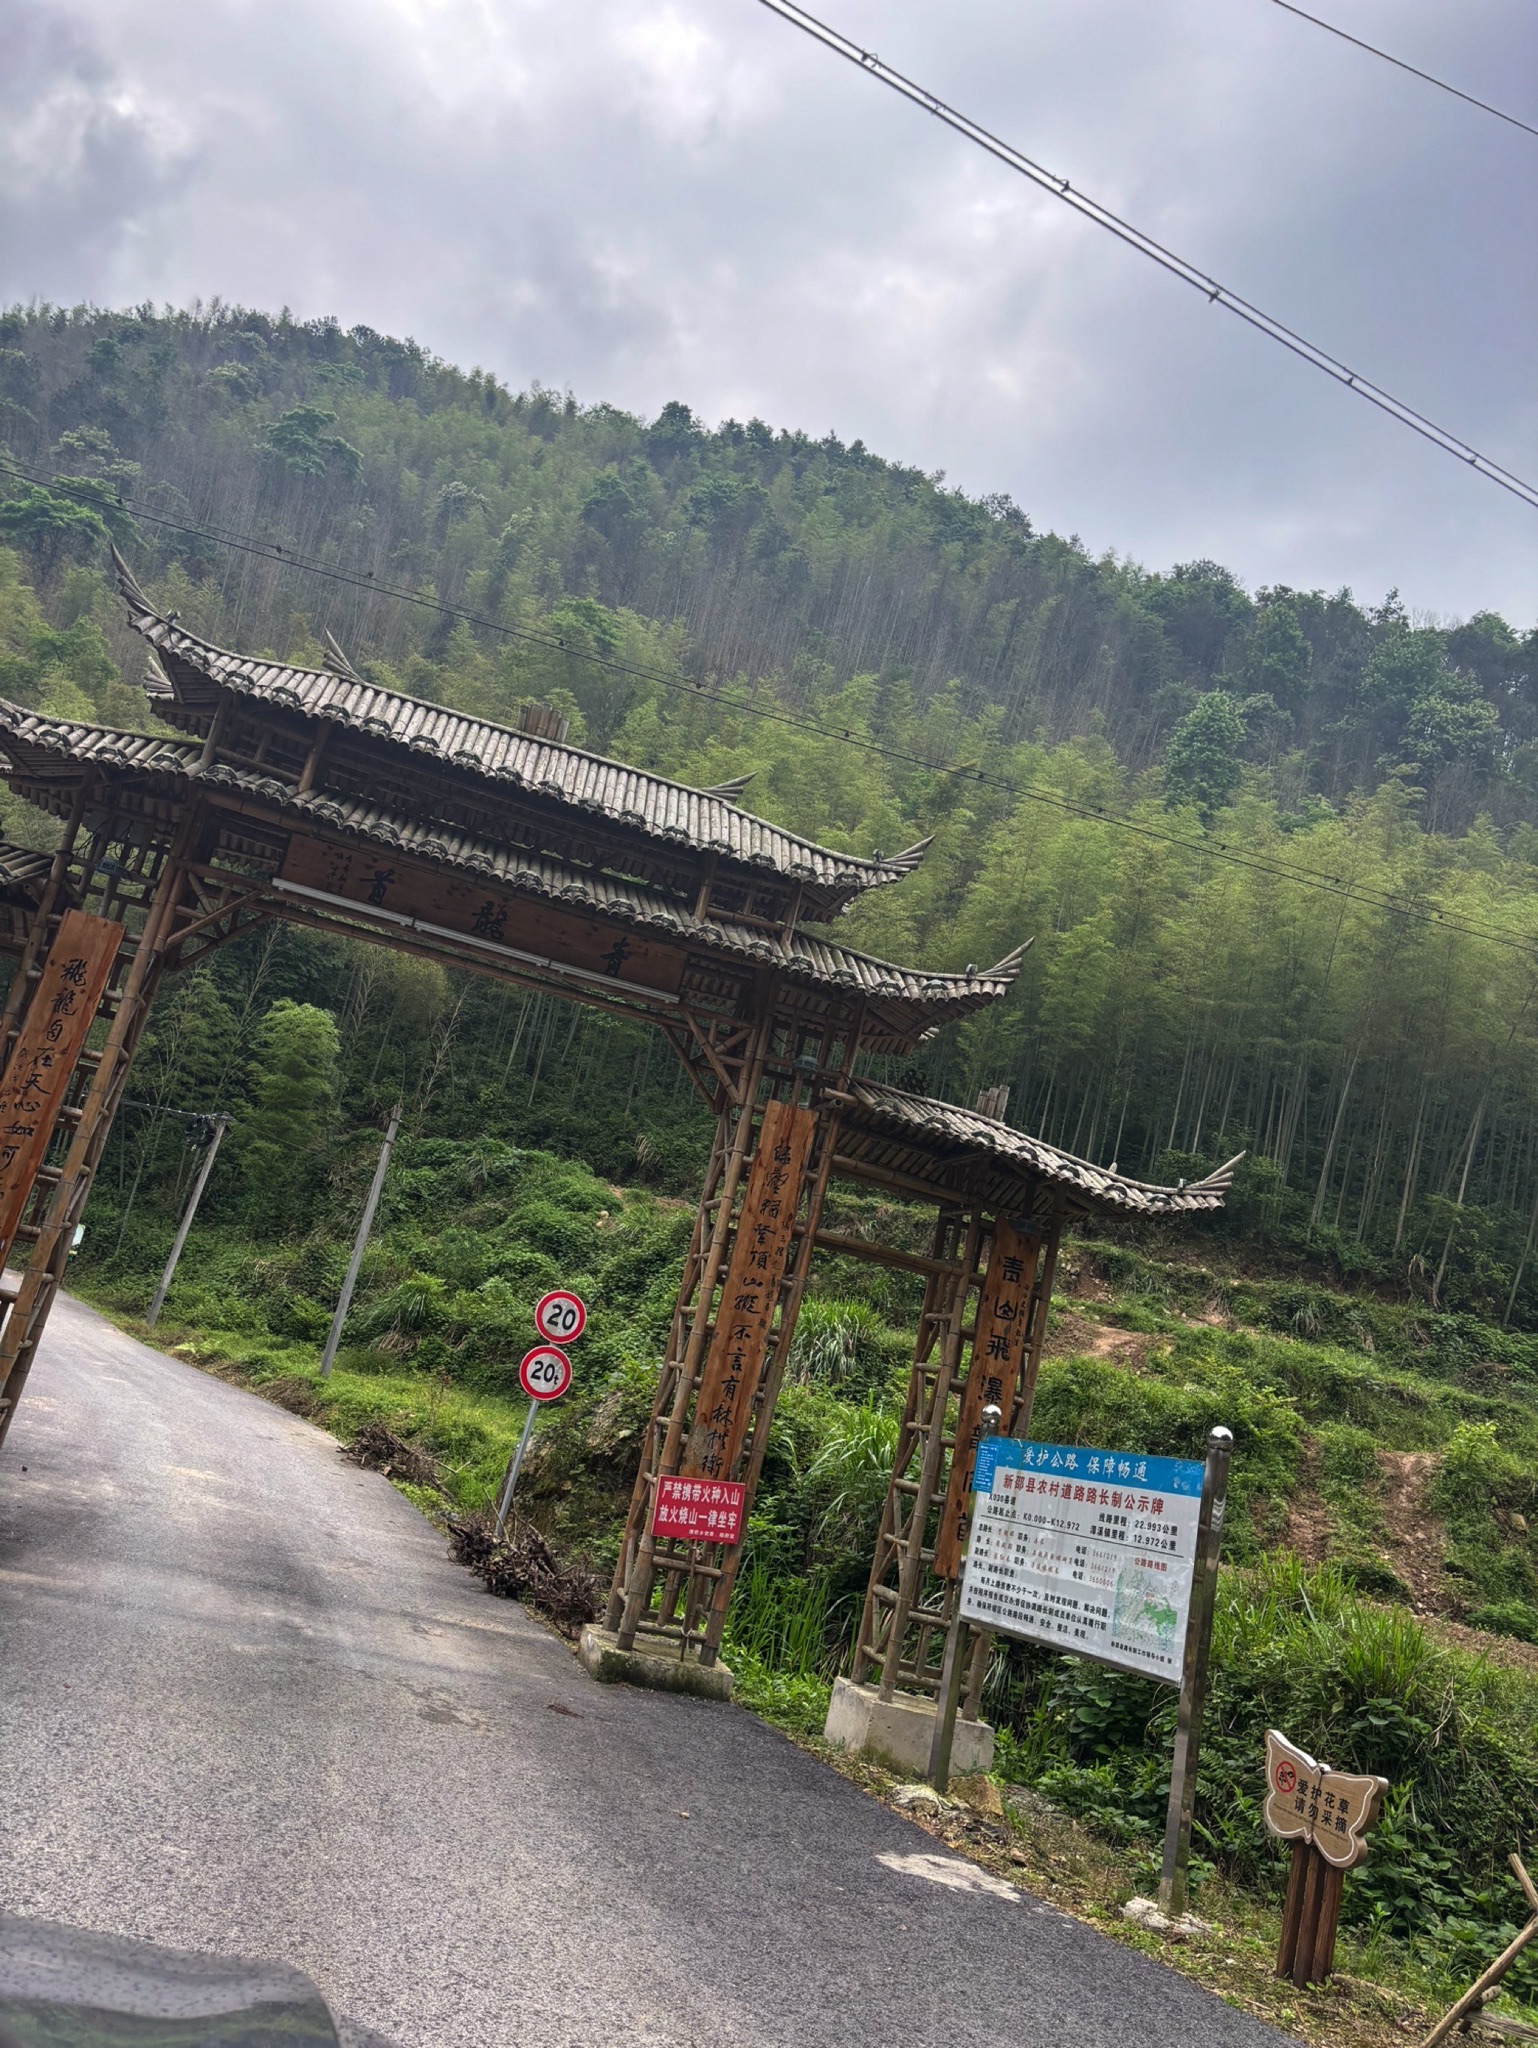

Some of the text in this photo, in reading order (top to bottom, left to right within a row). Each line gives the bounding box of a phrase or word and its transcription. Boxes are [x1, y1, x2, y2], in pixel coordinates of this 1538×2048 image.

[546, 1304, 576, 1331] 20
[530, 1360, 559, 1386] 20t
[1022, 1445, 1080, 1472] 爱护公路
[1085, 1453, 1149, 1483] 保障畅通
[662, 1481, 740, 1506] 严禁携带火种入山
[1002, 1473, 1164, 1516] 新邵县农村道路路长制公示牌
[658, 1504, 737, 1530] 放火烧山一律坐牢
[1133, 1556, 1167, 1572] 公路路线图
[1296, 1778, 1350, 1815] 爱护花草
[1294, 1797, 1347, 1834] 请勿采摘
